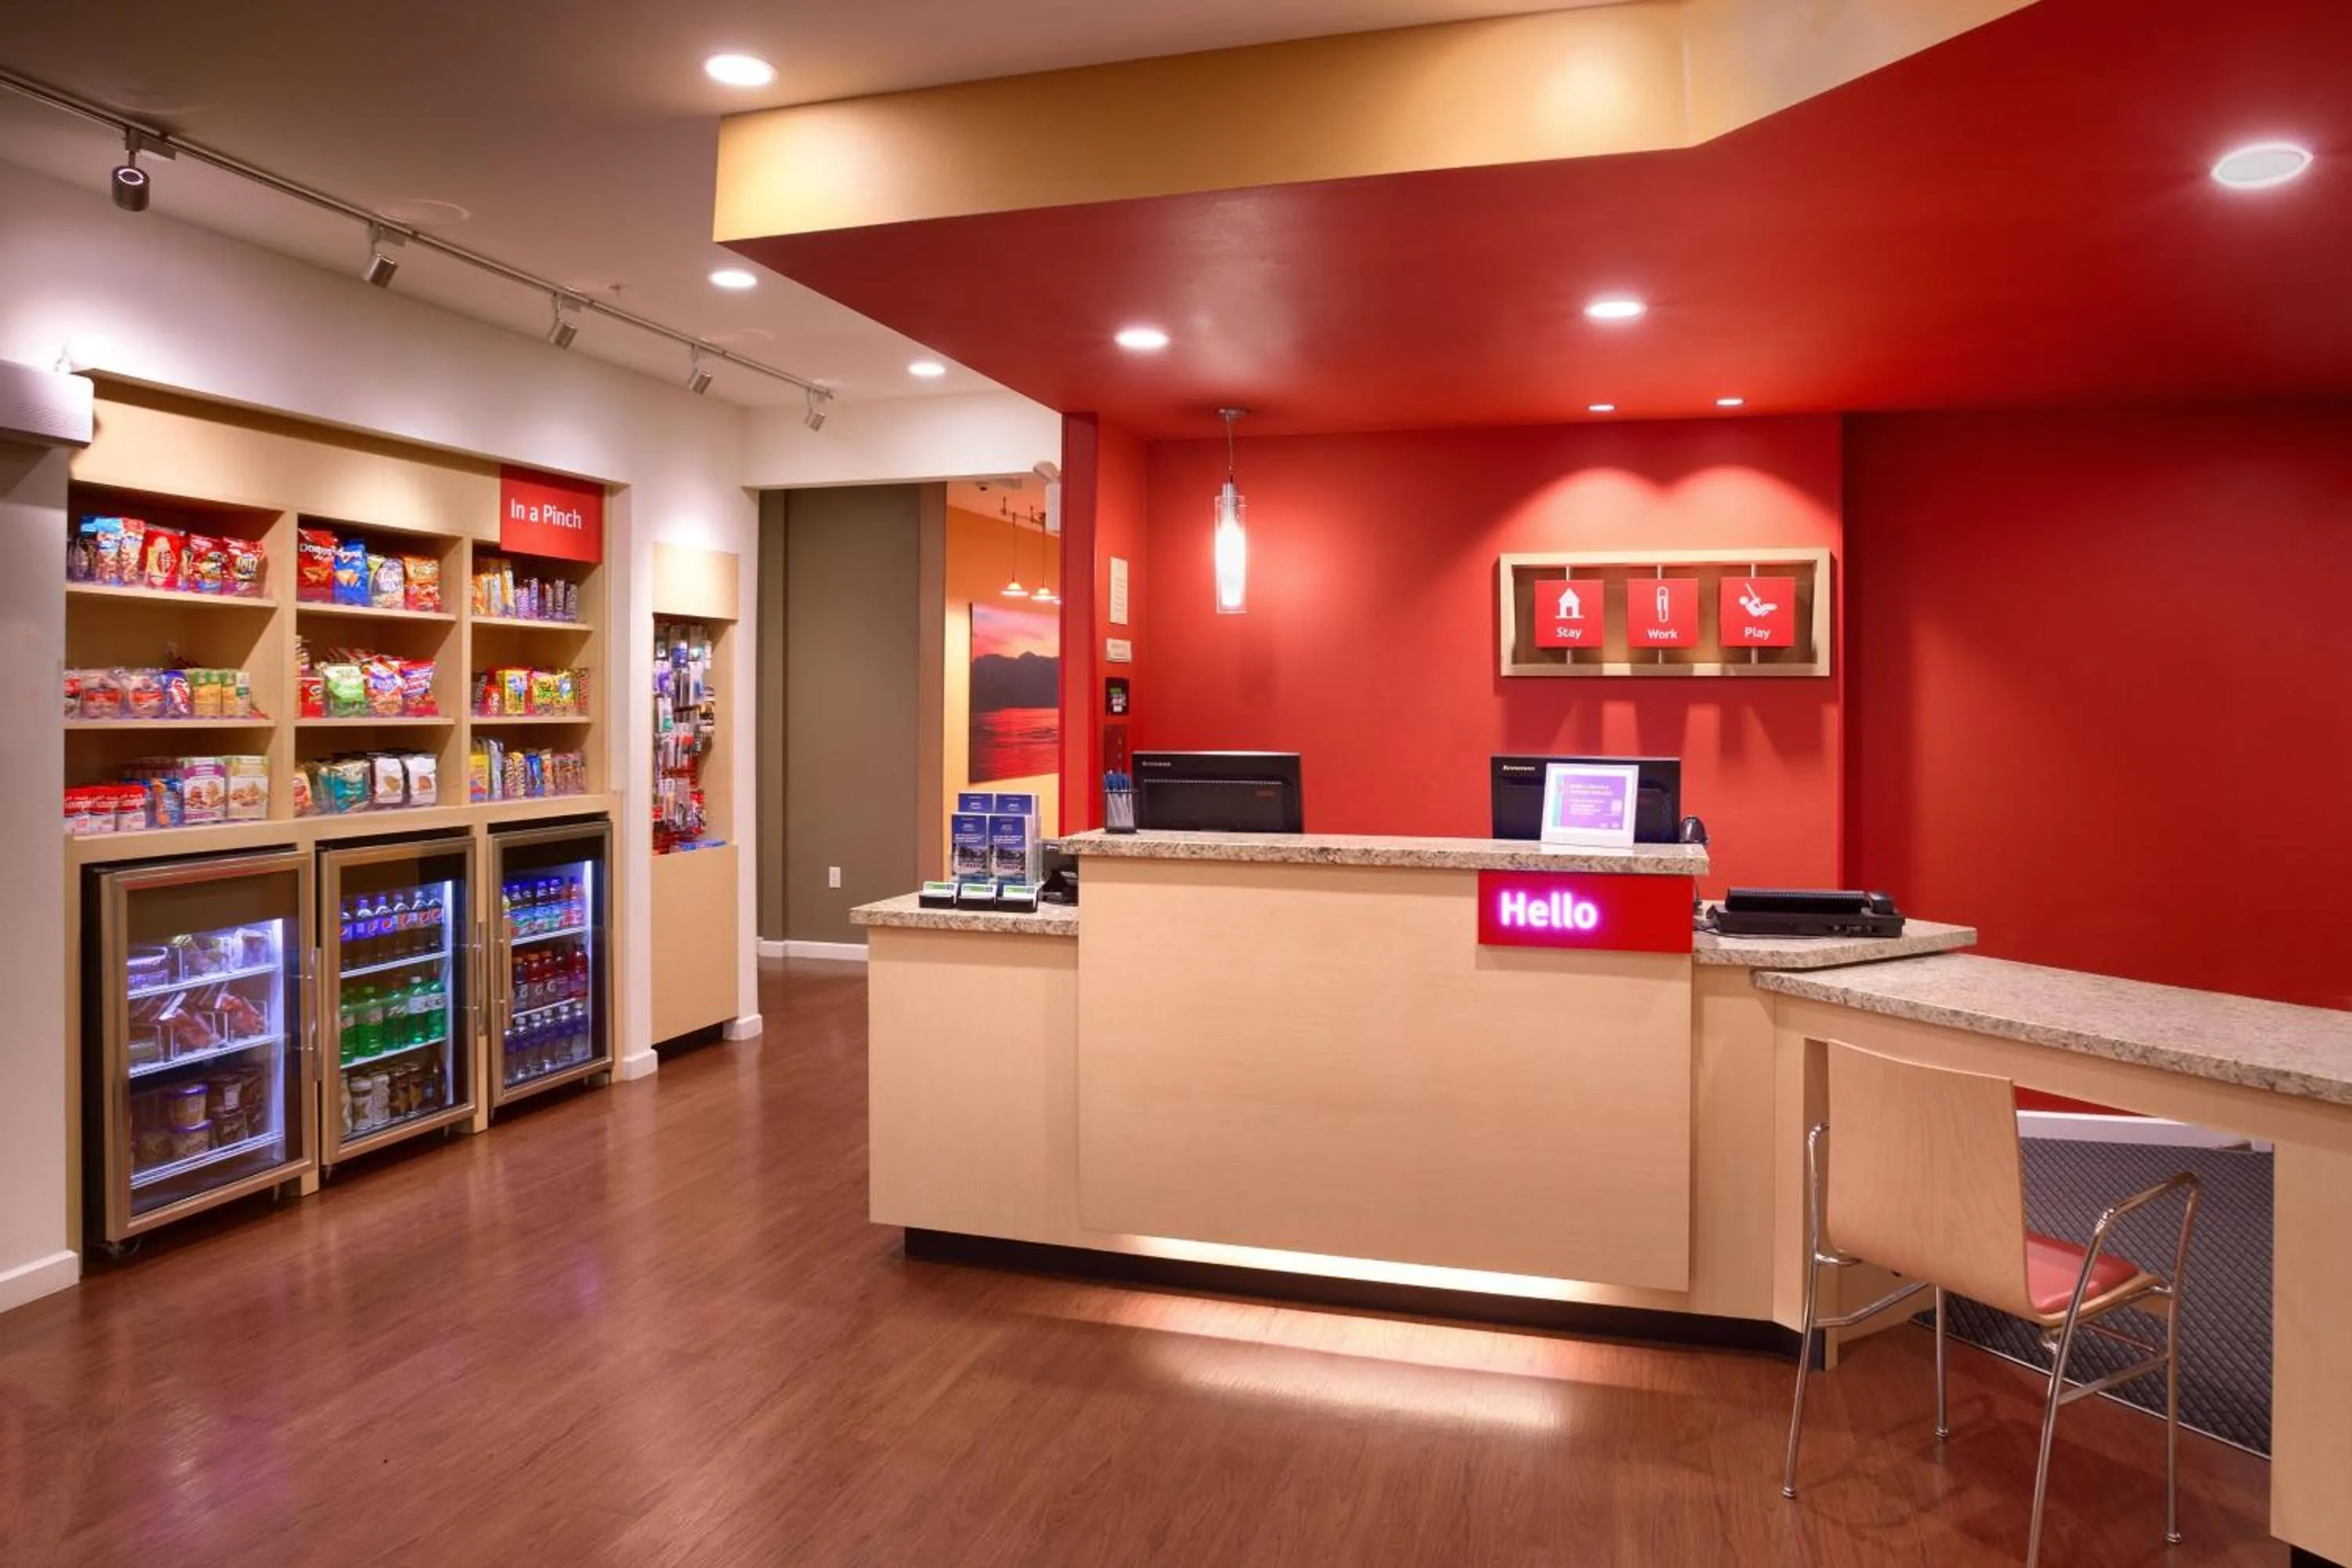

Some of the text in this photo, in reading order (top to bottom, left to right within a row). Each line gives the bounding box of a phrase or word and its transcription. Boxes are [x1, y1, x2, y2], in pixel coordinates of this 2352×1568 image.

[510, 498, 582, 529] In a Pinch
[1555, 626, 1582, 640] Stay
[1647, 628, 1678, 640] Work
[1744, 626, 1771, 641] Play
[1501, 891, 1599, 929] Hello
